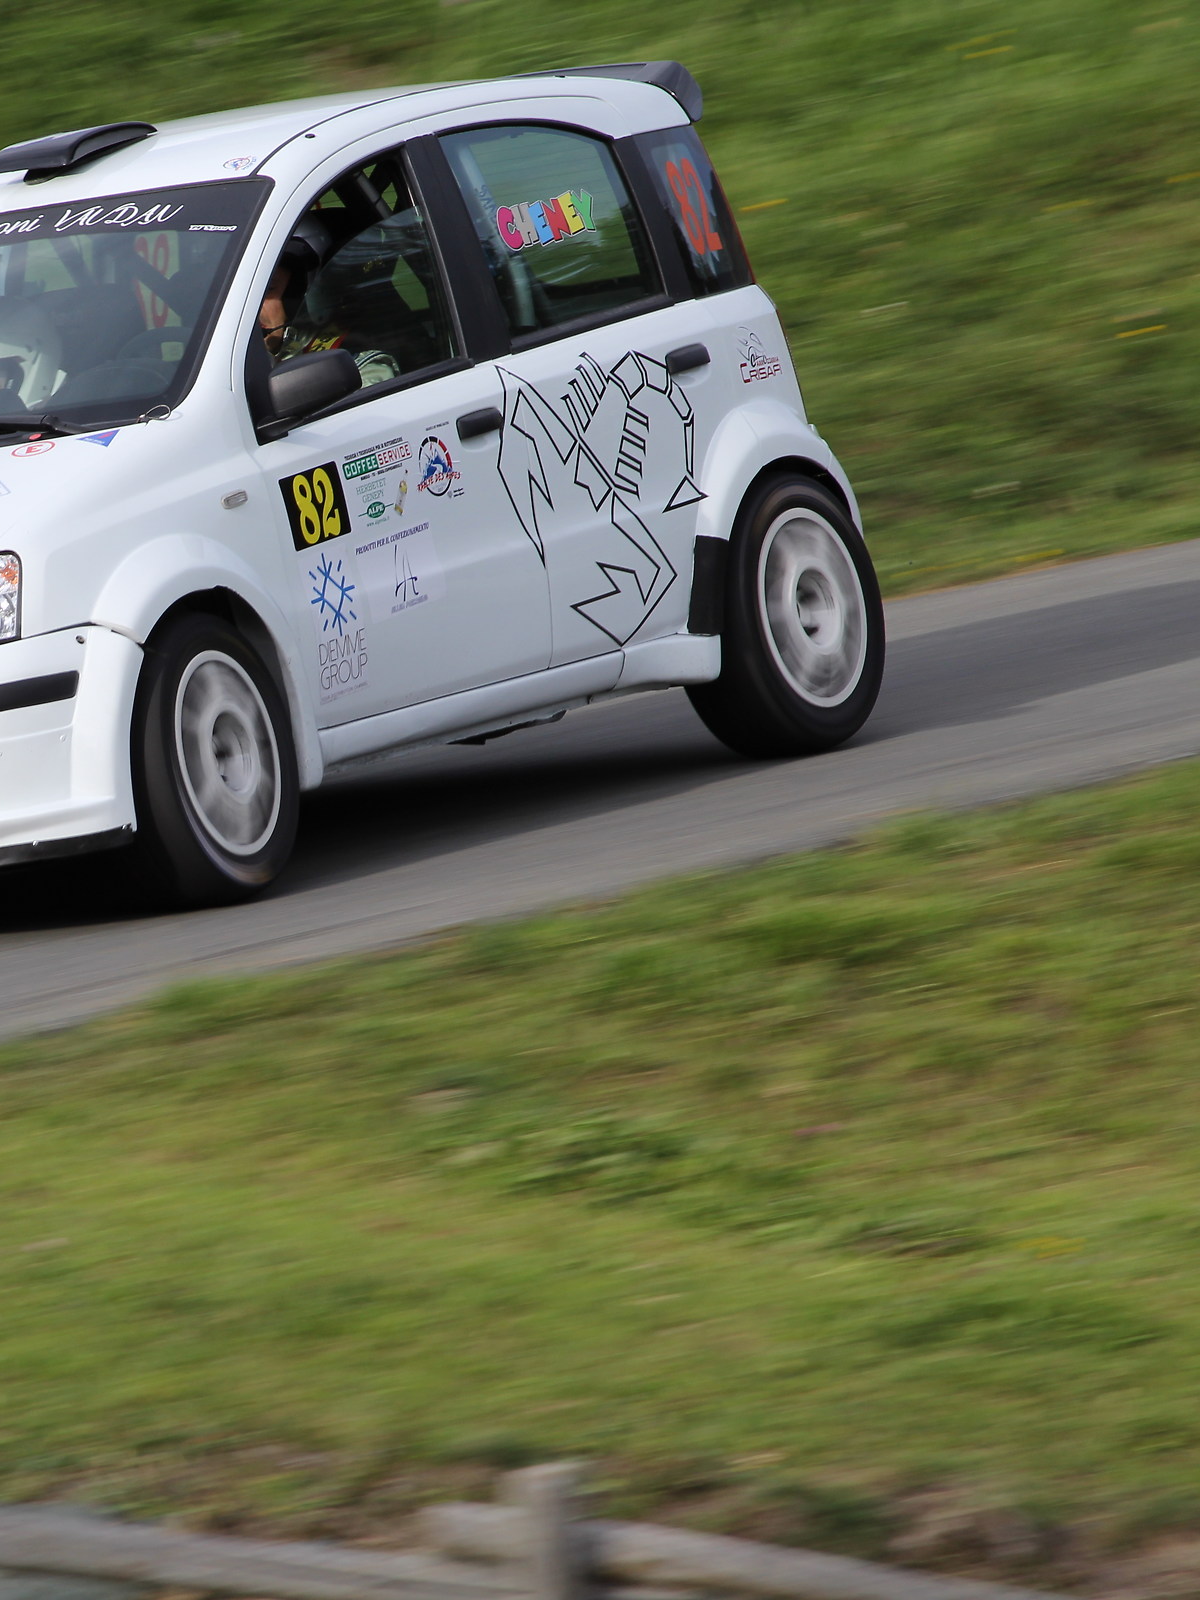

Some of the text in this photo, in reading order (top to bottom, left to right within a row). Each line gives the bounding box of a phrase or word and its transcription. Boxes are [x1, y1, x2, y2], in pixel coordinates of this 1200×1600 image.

[497, 190, 596, 251] CHENEY
[666, 158, 723, 255] 82
[344, 444, 412, 478] COFFEE SERVICE
[292, 468, 341, 545] 82
[368, 504, 384, 515] ALPE
[356, 541, 377, 555] PRODOTTI
[376, 537, 386, 549] PER
[318, 627, 367, 666] DIEMME
[320, 652, 368, 690] GROUP
